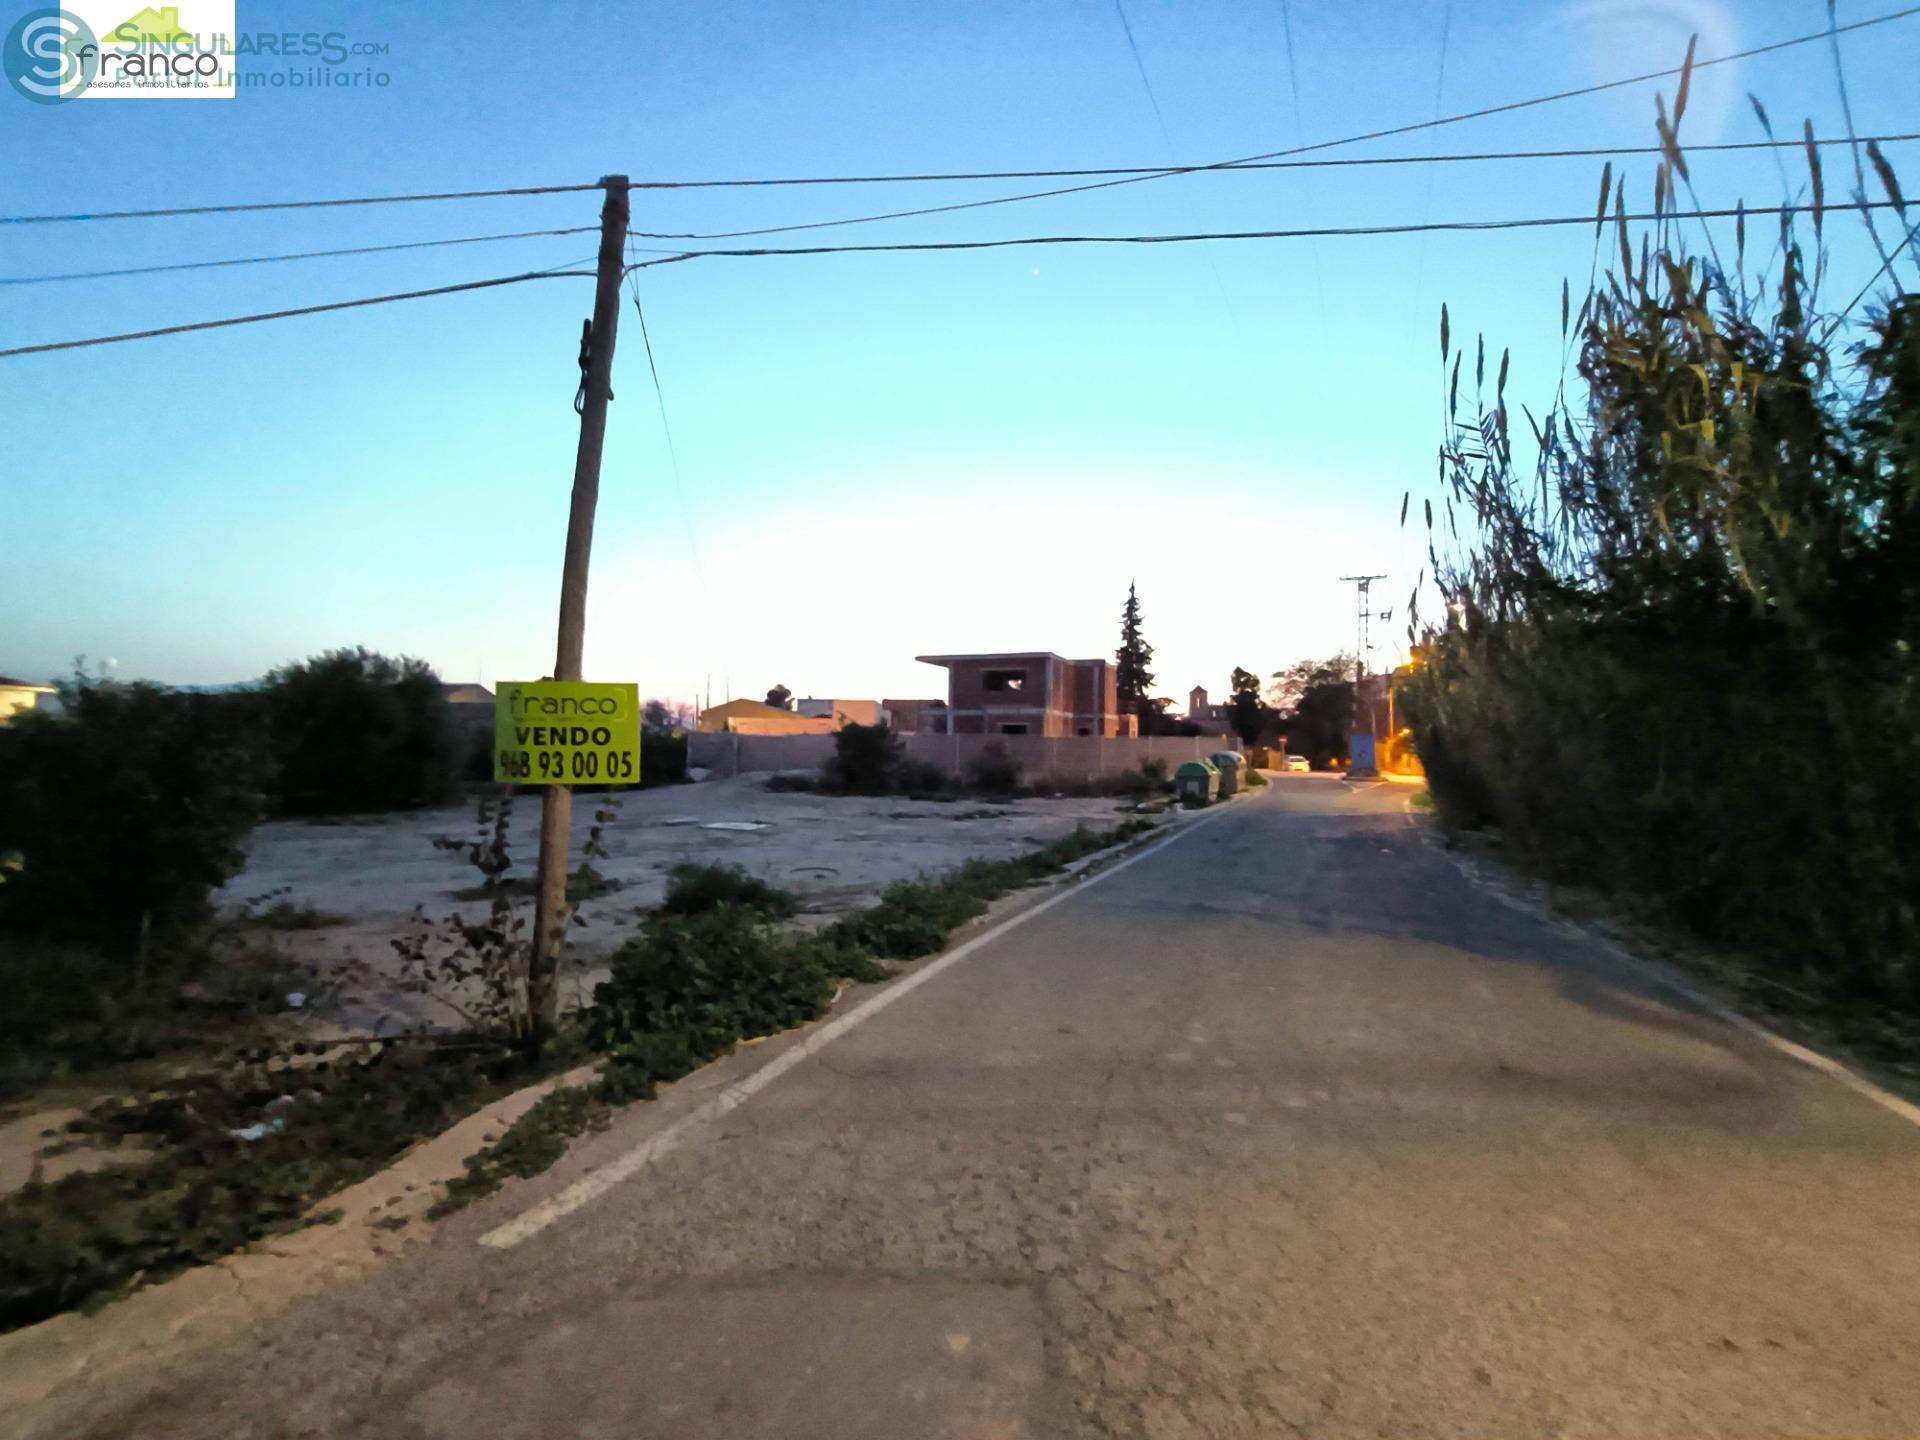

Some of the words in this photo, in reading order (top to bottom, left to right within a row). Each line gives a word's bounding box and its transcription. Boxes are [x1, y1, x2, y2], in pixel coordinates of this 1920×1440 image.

[510, 689, 617, 715] franco
[514, 726, 611, 746] VENDO
[538, 751, 564, 778] 93
[572, 751, 598, 778] 00
[606, 751, 632, 778] 05
